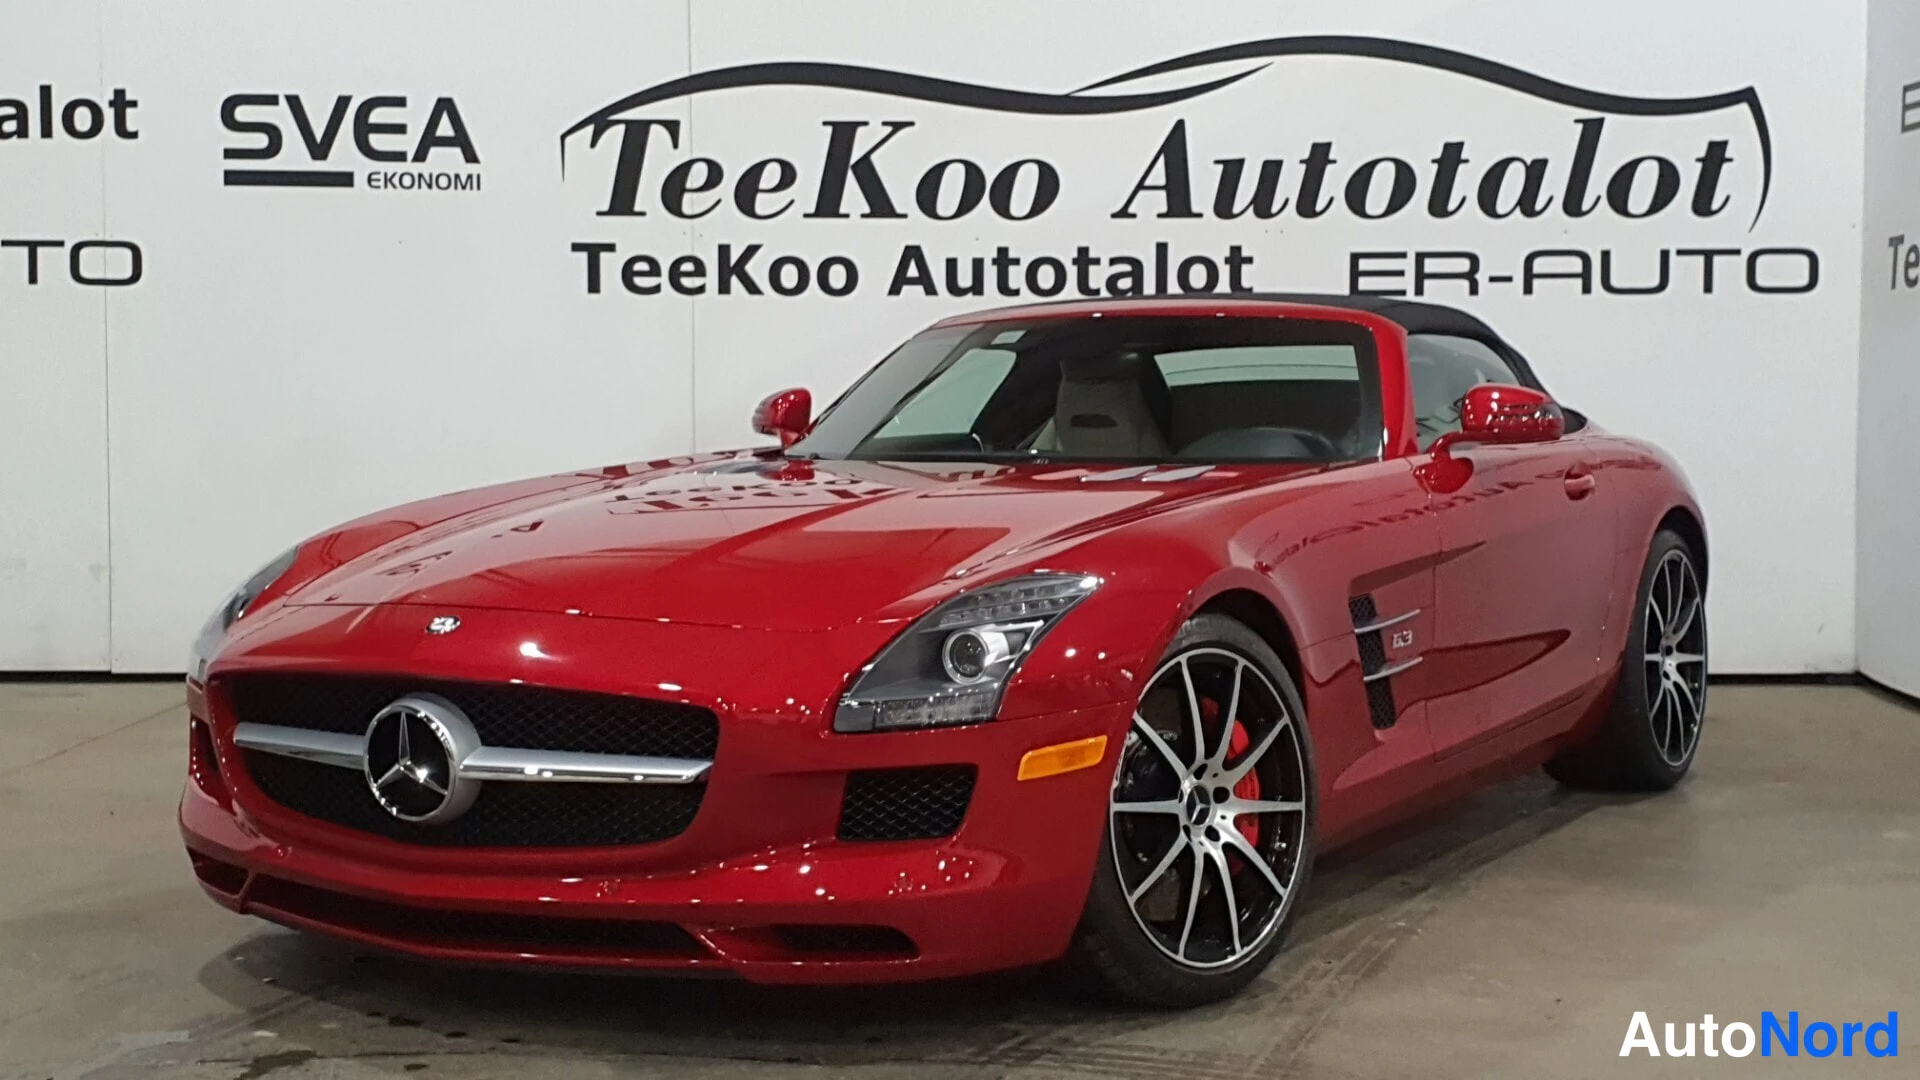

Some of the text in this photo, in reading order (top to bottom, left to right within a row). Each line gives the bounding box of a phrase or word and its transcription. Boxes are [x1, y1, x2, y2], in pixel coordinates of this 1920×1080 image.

[0, 85, 138, 139] alot
[220, 94, 480, 163] SVEA
[366, 171, 481, 191] EKONOMI
[589, 117, 1734, 220] TeeKoo Autotalot
[1, 240, 142, 286] TO
[571, 242, 1254, 296] TeeKoo Autotalot
[1349, 248, 1819, 297] ER-AUTO
